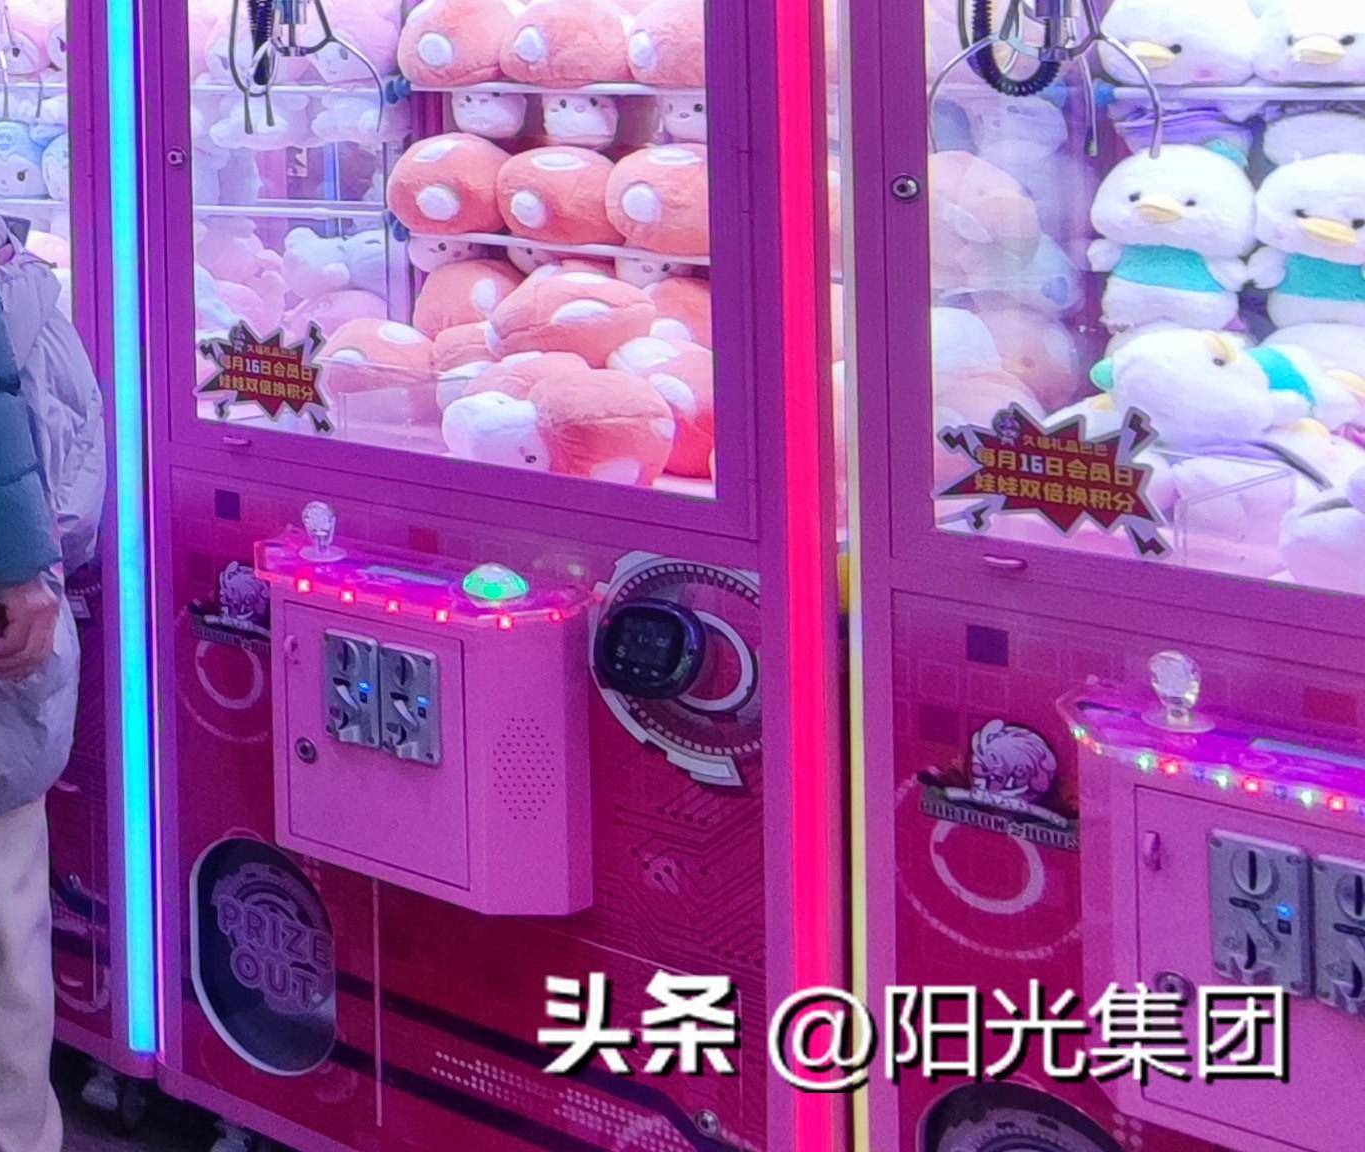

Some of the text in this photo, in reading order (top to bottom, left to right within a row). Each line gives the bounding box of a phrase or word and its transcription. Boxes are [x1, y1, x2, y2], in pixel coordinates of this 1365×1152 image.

[976, 447, 1135, 487] 每月16日会员日
[974, 472, 1137, 514] 娃娃双倍换积分
[218, 899, 332, 970] PRIZE
[234, 954, 320, 1010] OUT
